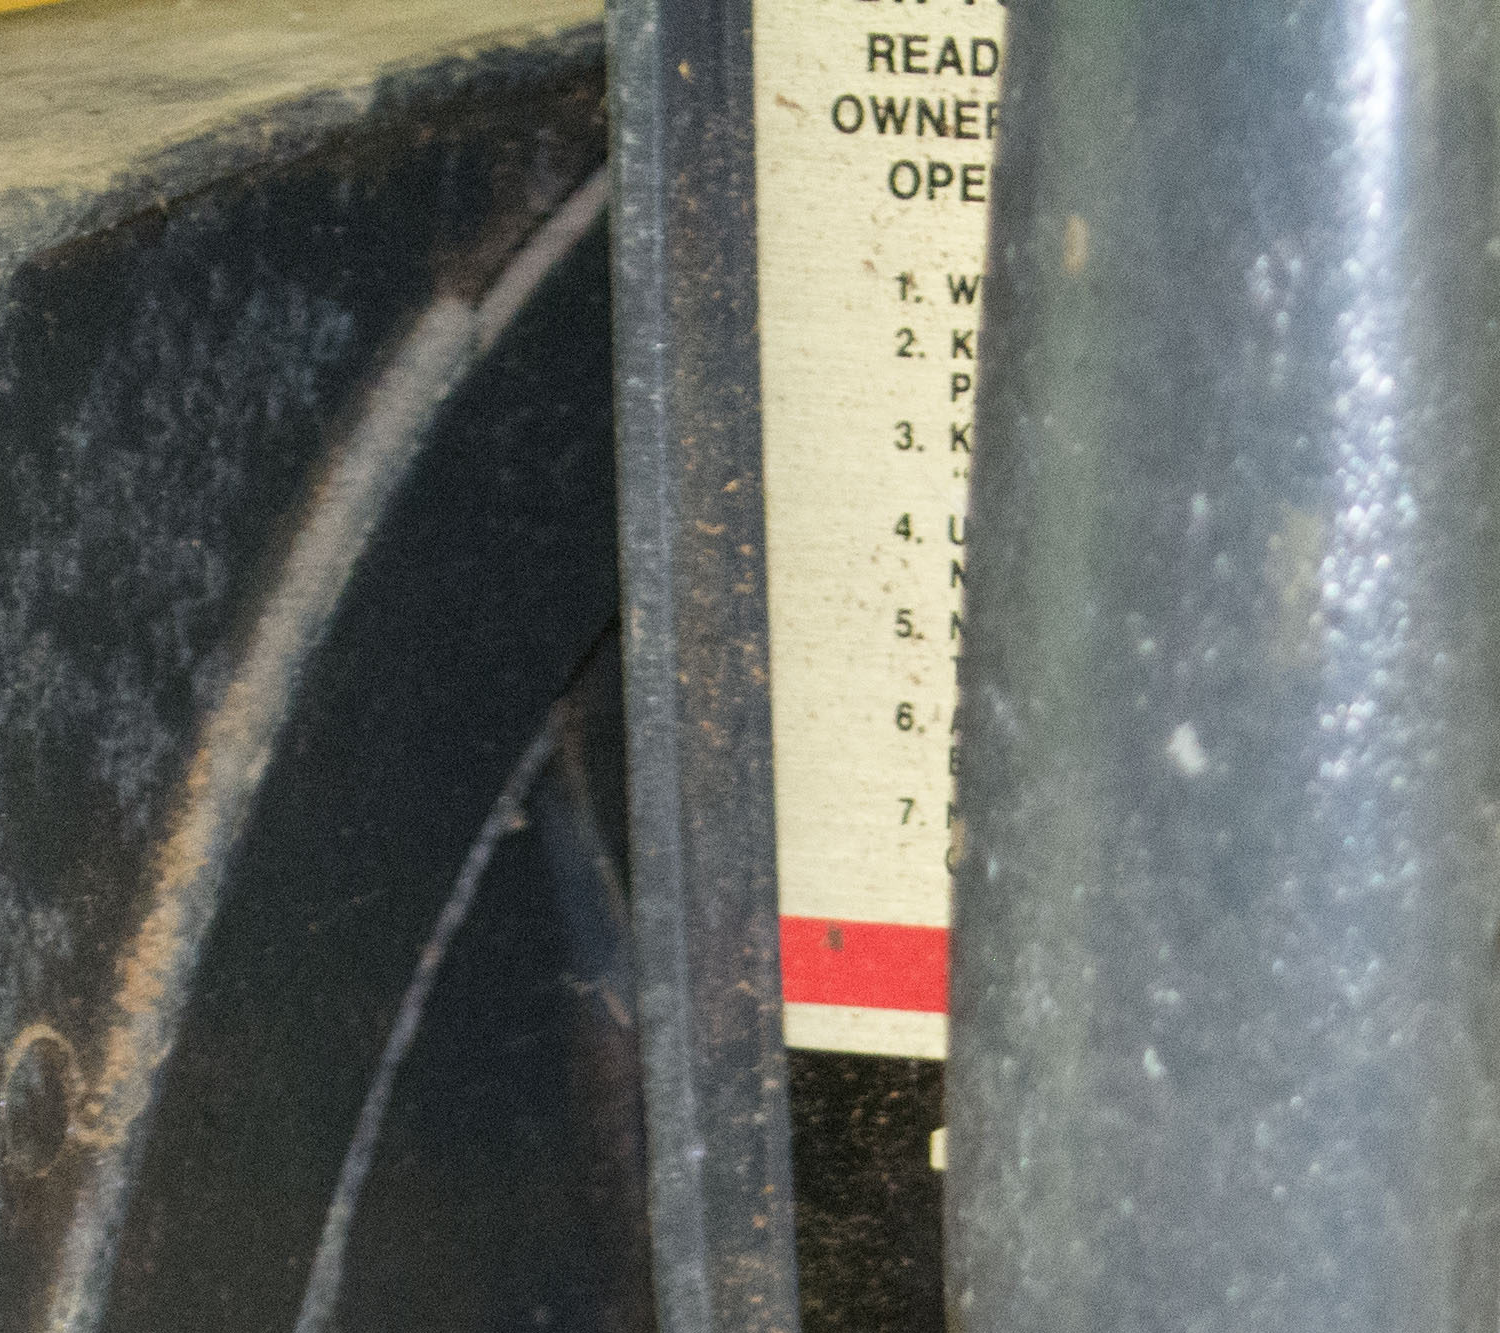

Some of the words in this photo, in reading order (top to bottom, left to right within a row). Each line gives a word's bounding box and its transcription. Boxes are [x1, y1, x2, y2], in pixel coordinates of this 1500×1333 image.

[867, 32, 1000, 77] READ
[895, 272, 924, 304] 1.
[896, 327, 926, 358] 2.
[894, 420, 925, 452] 3.
[894, 512, 923, 543] 4.
[896, 608, 925, 640] 5.
[896, 702, 926, 734] 6.
[898, 798, 926, 827] 7.
